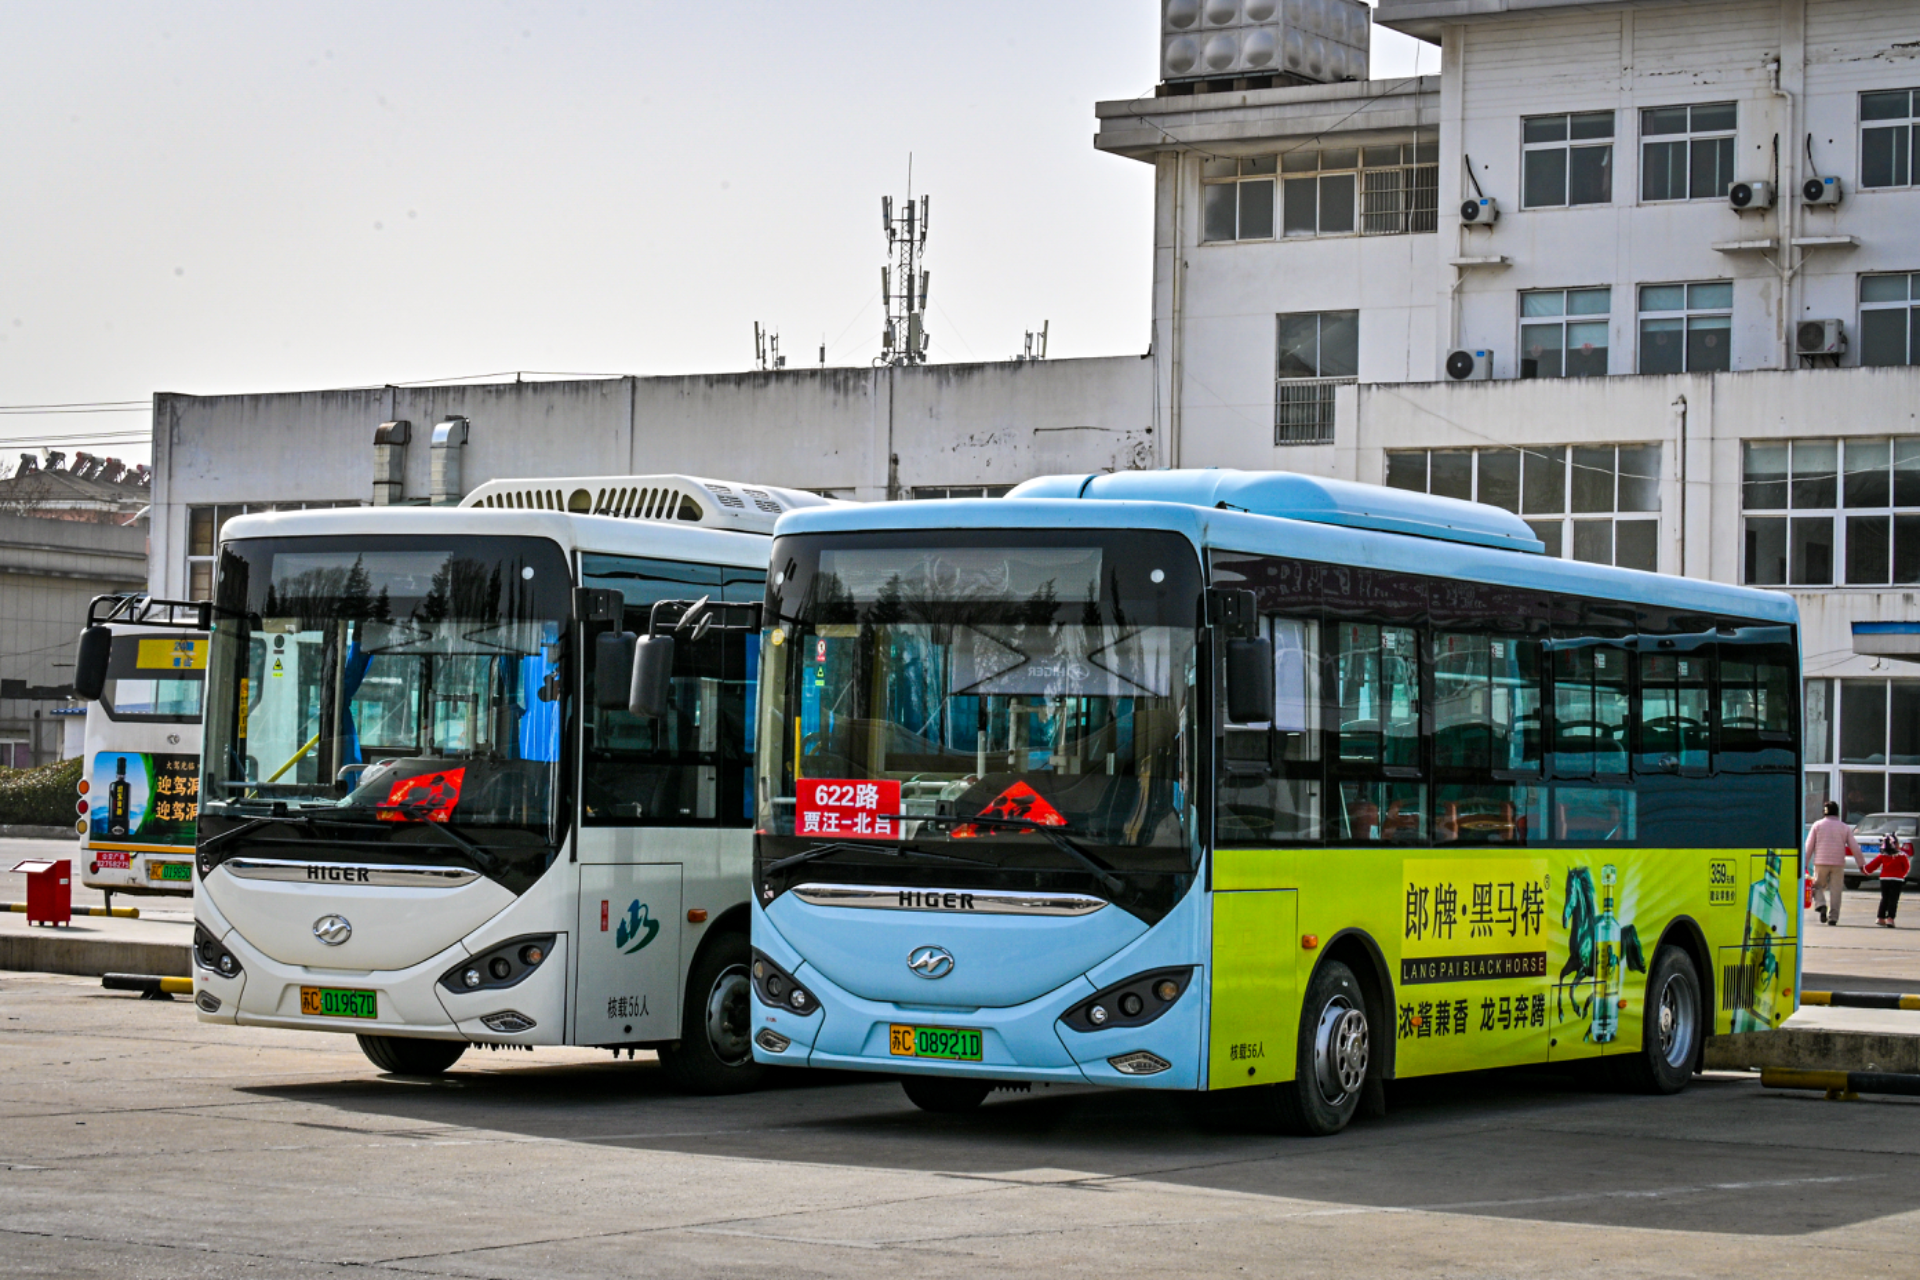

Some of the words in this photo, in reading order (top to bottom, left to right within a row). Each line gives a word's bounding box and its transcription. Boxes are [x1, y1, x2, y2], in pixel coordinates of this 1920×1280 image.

[815, 783, 879, 809] 622路
[307, 864, 369, 882] HIGER
[899, 890, 974, 909] HIGER
[1403, 963, 1436, 980] LANG
[1440, 961, 1460, 977] PAI
[1463, 958, 1502, 976] BLACK
[1505, 956, 1545, 974] HORSE
[607, 995, 649, 1019] 核载56人
[1398, 999, 1468, 1040] 浓酱兼香
[1480, 993, 1546, 1032] 龙马奔腾
[1230, 1041, 1265, 1061] 核载56人
